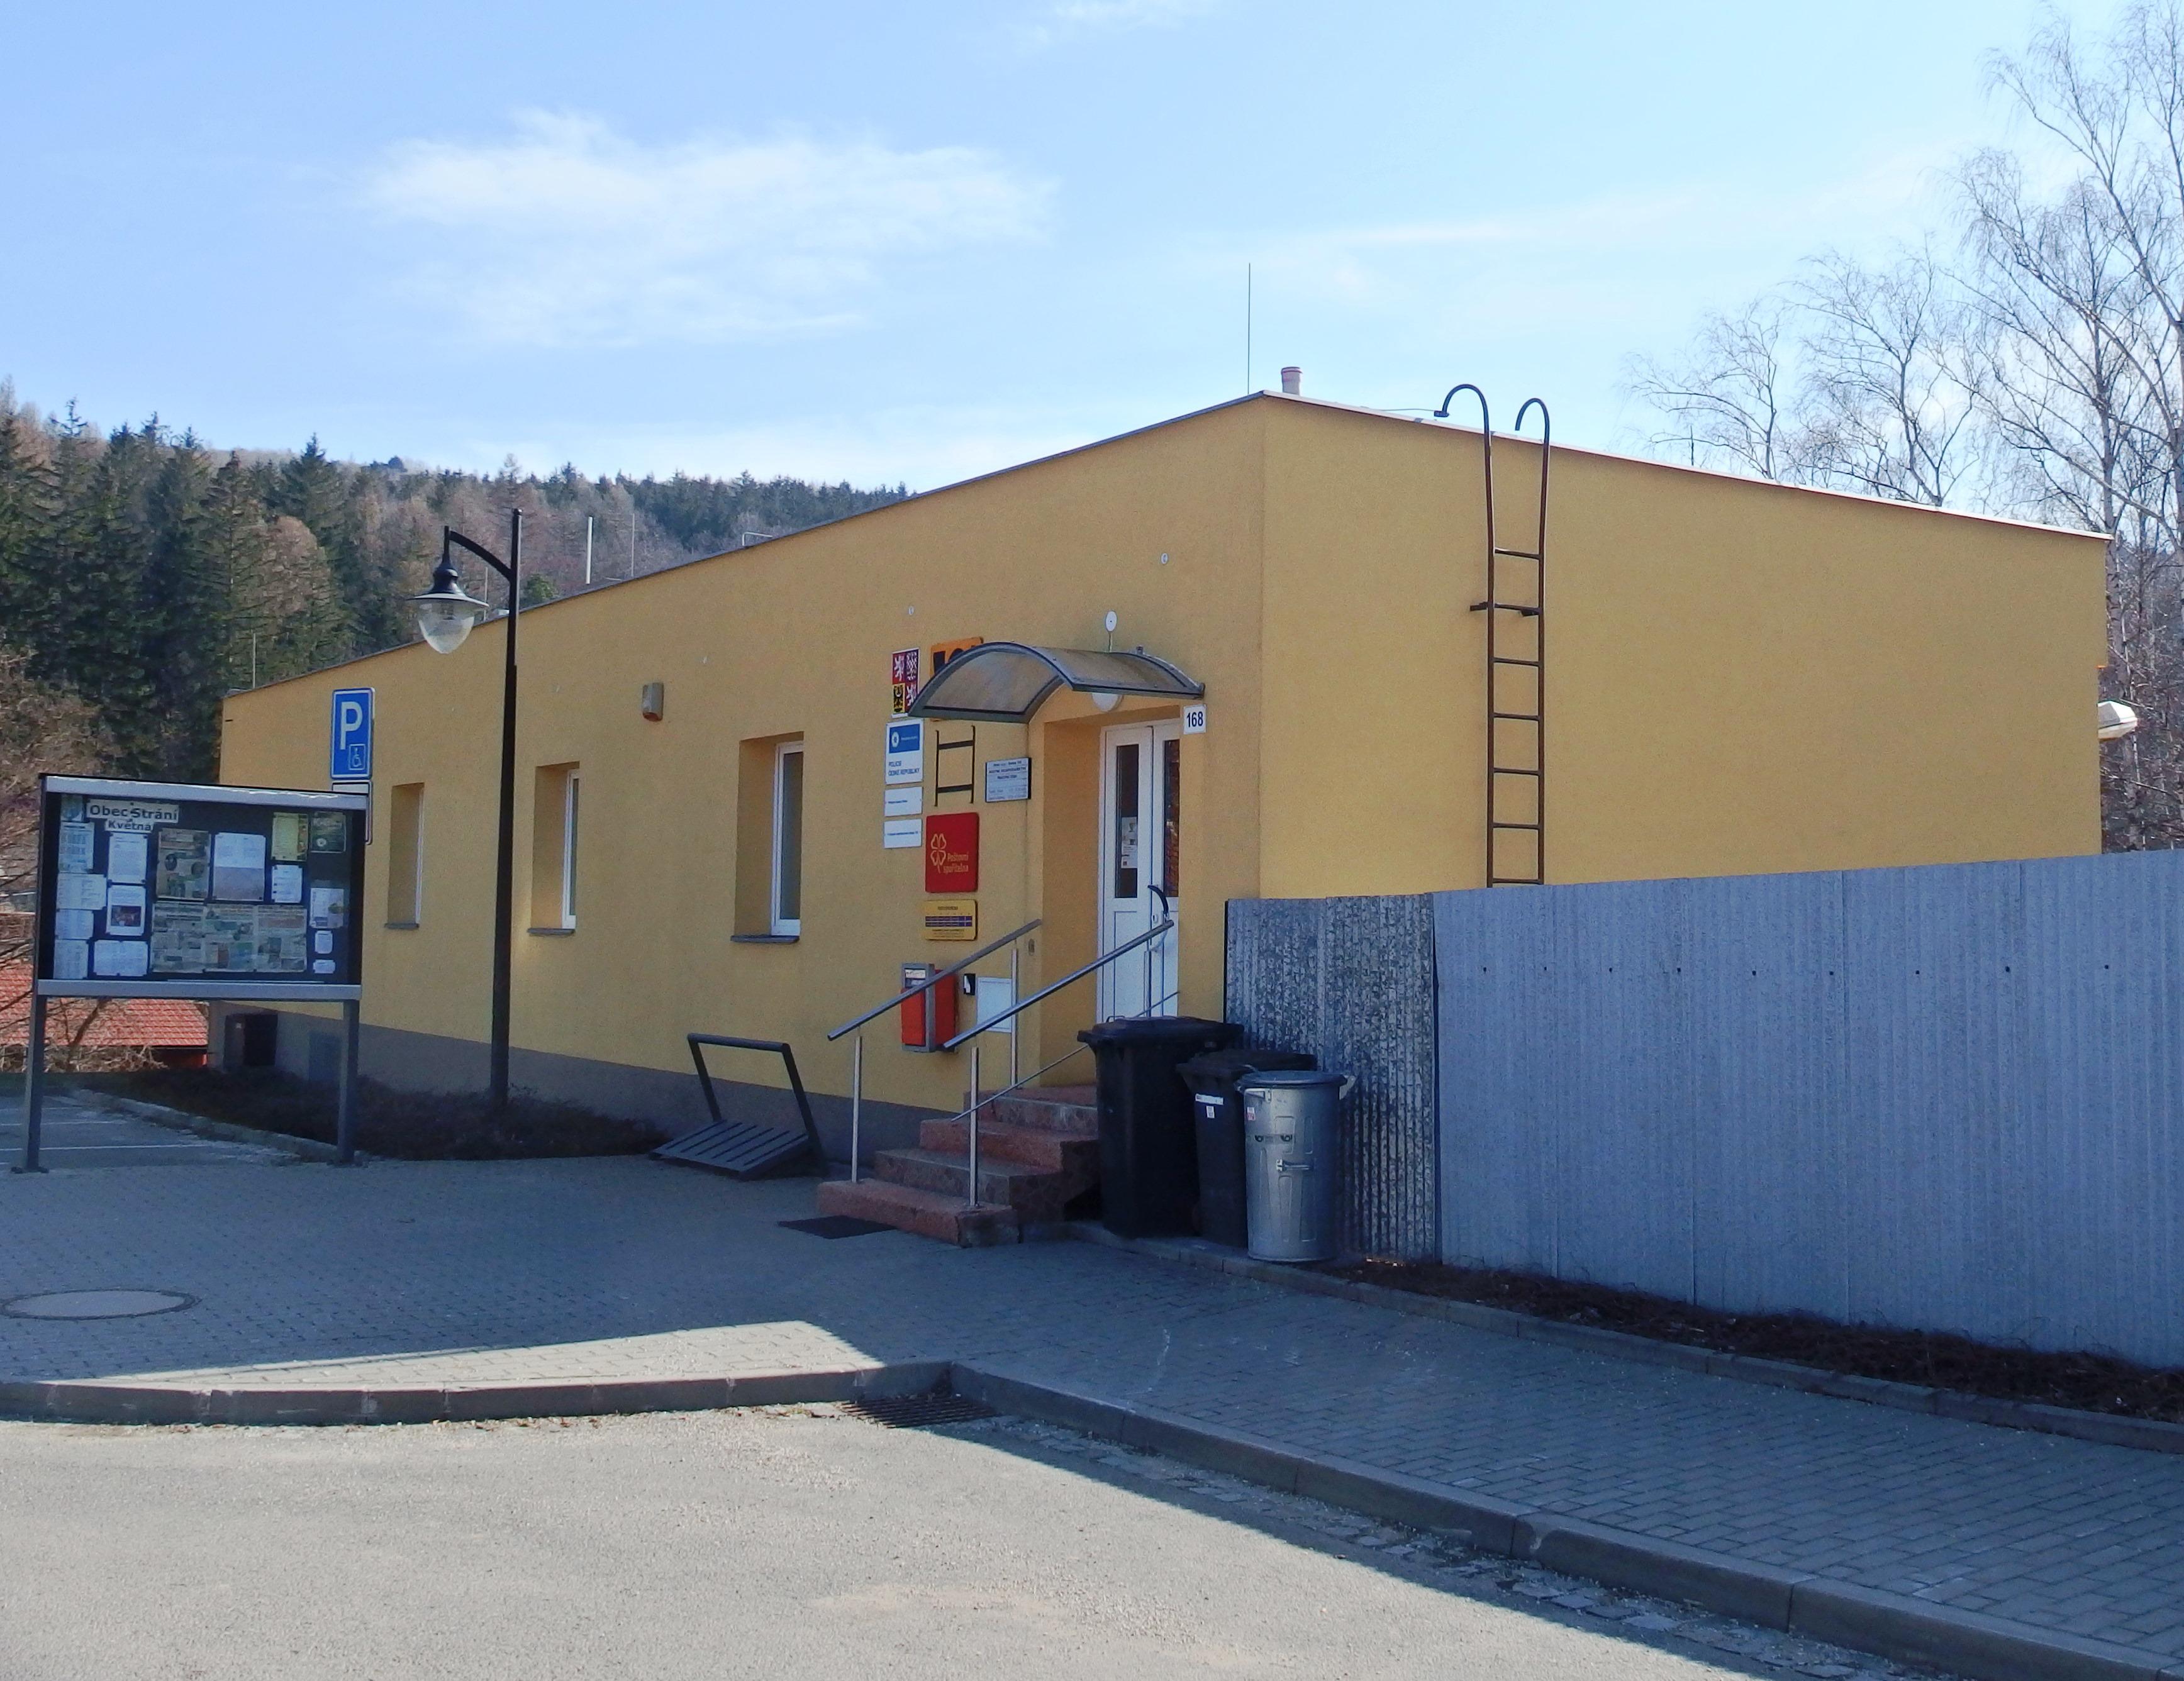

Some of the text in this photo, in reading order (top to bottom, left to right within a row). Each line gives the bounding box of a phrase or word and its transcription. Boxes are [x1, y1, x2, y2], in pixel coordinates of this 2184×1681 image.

[340, 701, 363, 750] P
[1186, 711, 1203, 728] 168
[90, 805, 177, 820] Obec Strání
